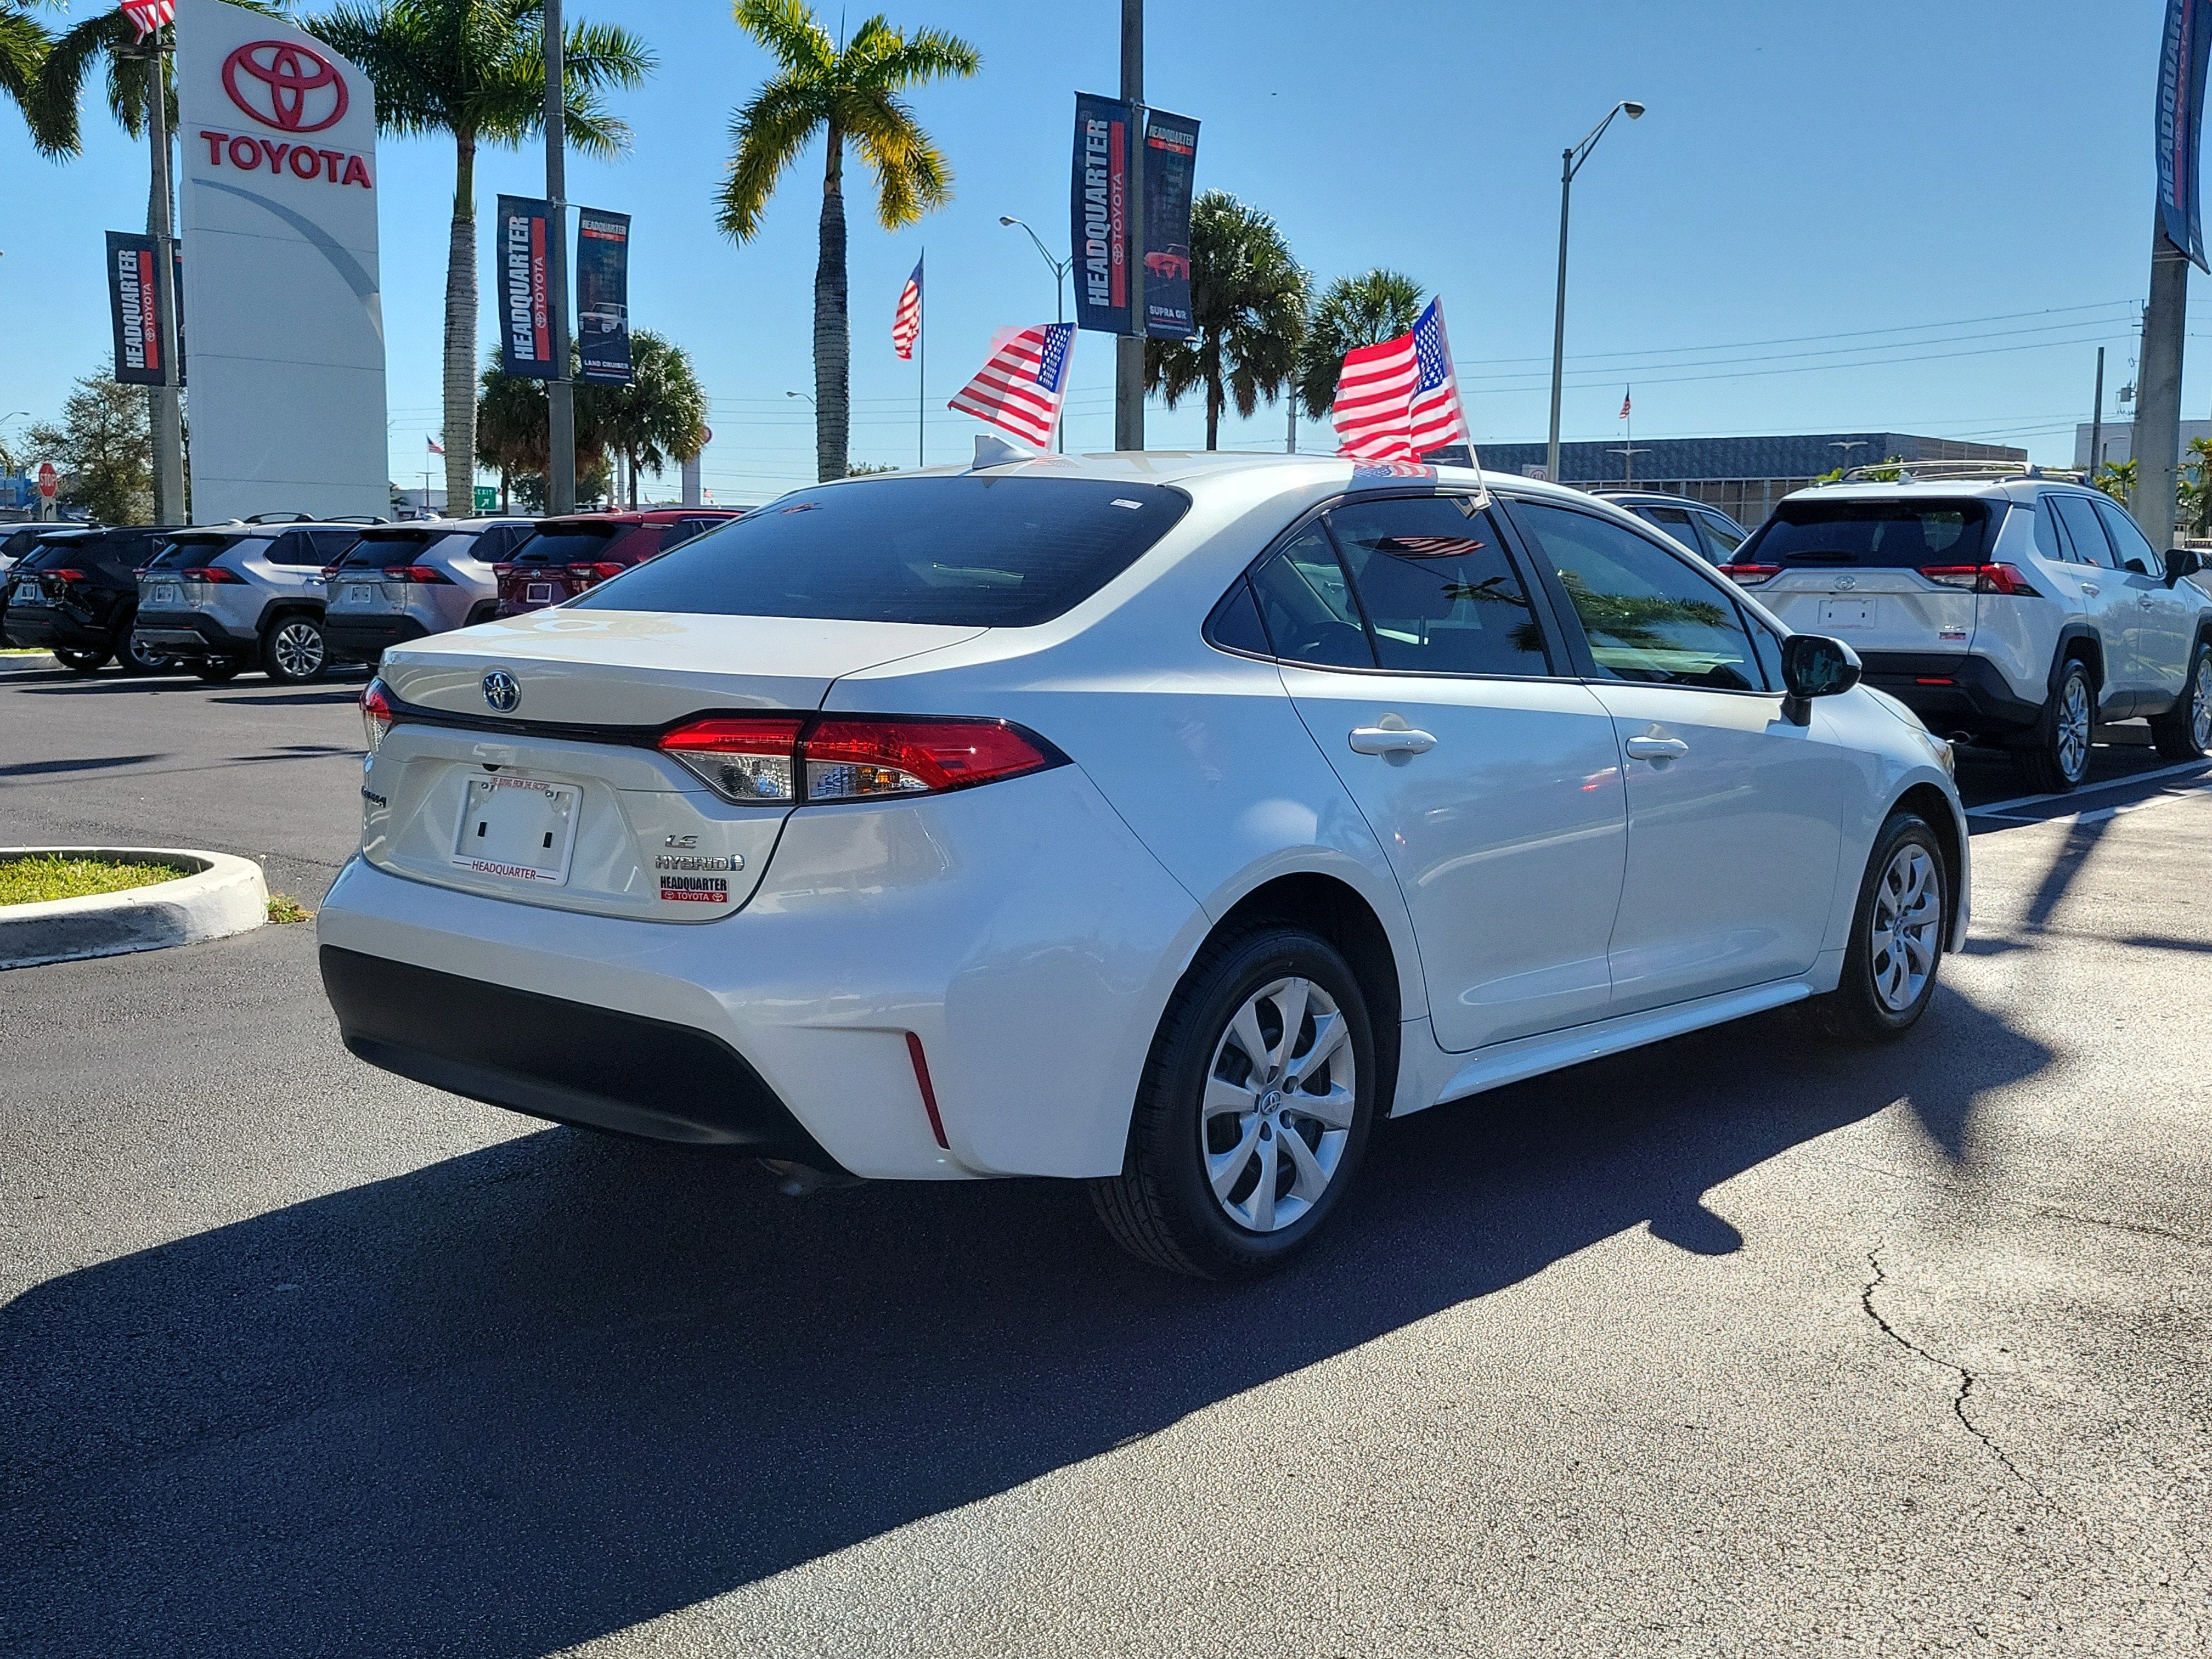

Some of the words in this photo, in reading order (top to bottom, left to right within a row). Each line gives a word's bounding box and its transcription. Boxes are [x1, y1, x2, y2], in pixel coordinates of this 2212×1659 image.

[200, 131, 372, 188] TOYOTA
[1085, 119, 1111, 307] HEADQUARTER
[1113, 173, 1122, 240] TOYOTA
[508, 216, 534, 360] HEADQUARTER
[534, 256, 545, 310] TOYOTA
[118, 250, 145, 369] HEADQUARTER
[143, 283, 154, 326] TOYOTA
[1149, 304, 1175, 318] SUPRA
[1175, 309, 1187, 320] GR
[602, 361, 629, 370] CRUISER
[40, 473, 56, 487] STOP
[665, 834, 699, 849] LE
[472, 860, 536, 880] HEADQUARTER
[655, 854, 729, 871] HYBRID
[660, 876, 727, 891] HEADQUARTER
[677, 891, 709, 901] TOYOTA
